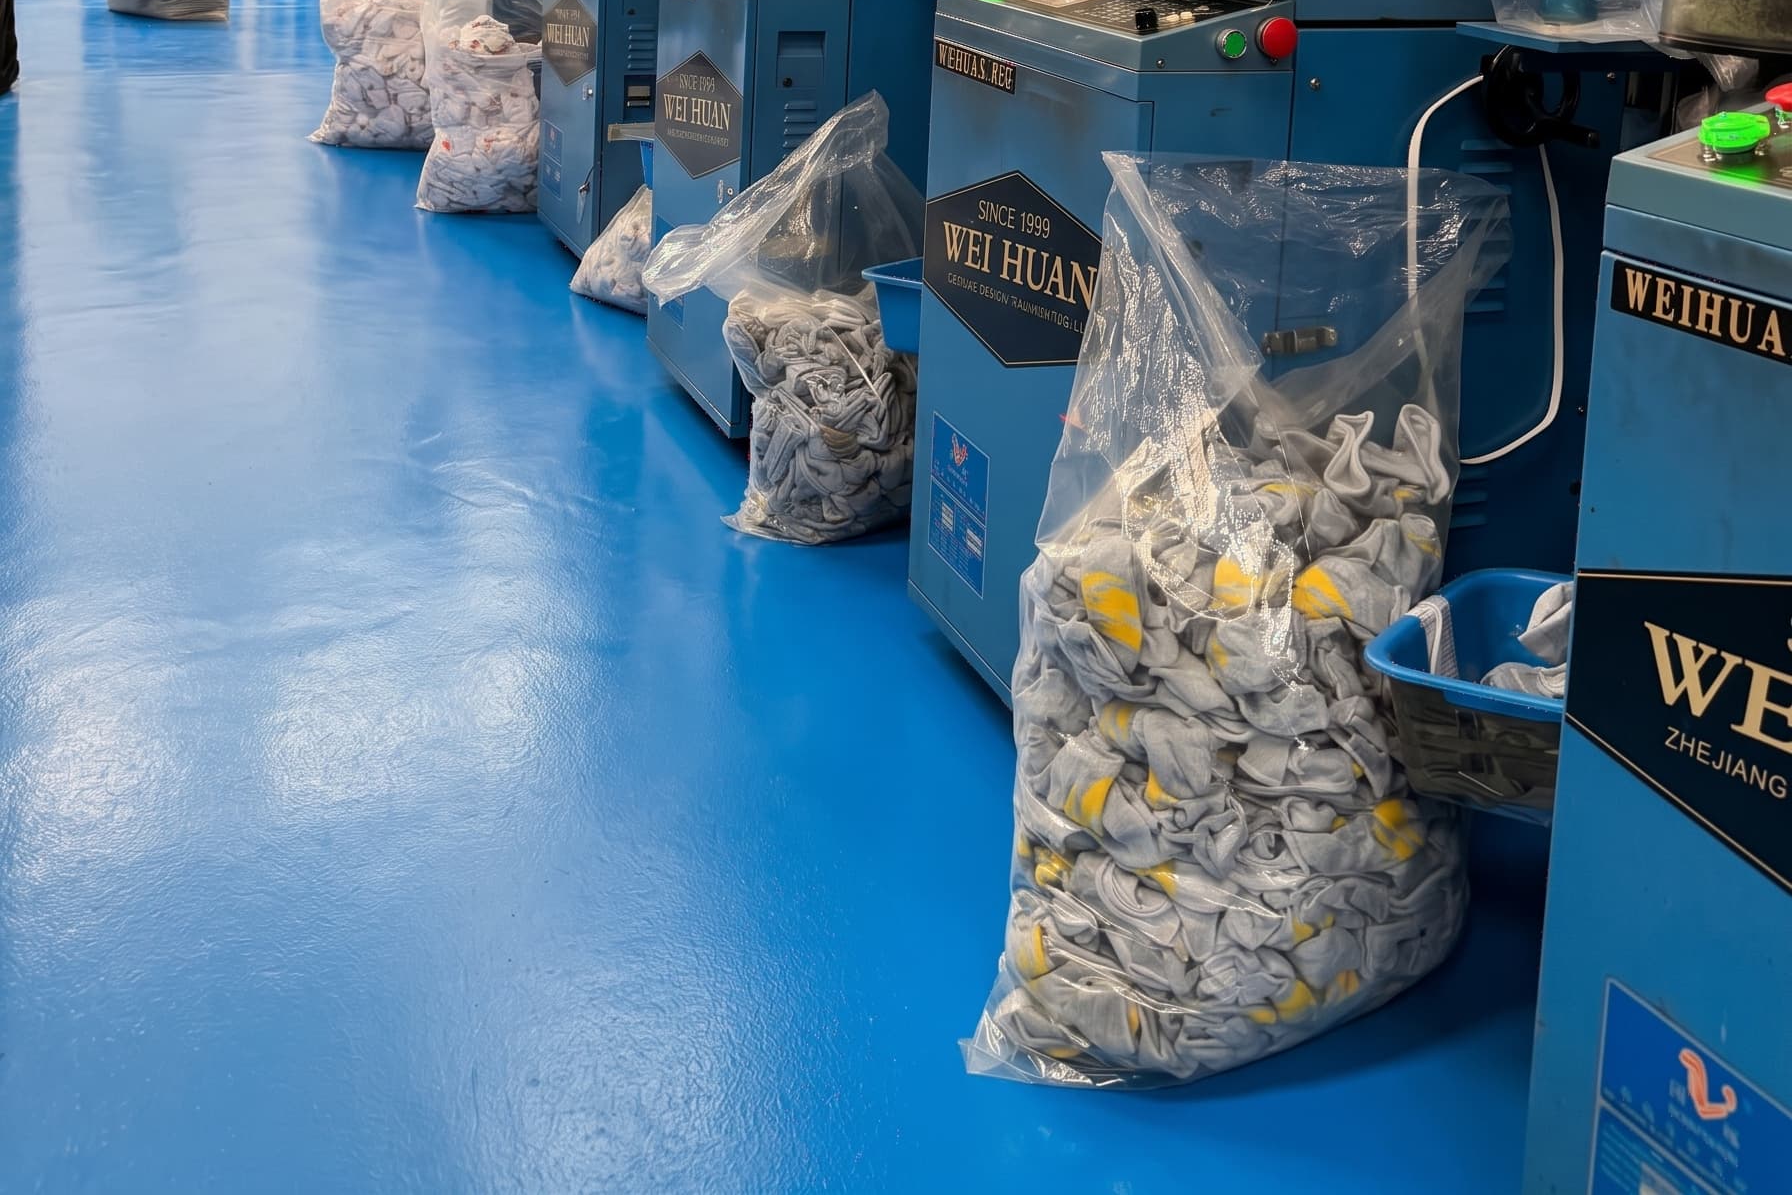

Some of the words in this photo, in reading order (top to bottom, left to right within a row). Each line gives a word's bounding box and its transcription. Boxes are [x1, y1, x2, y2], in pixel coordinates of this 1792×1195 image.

[663, 93, 688, 123] WEI
[691, 97, 731, 131] HUAN
[978, 199, 1016, 229] SINCE
[1020, 211, 1050, 239] 1999
[943, 221, 993, 273] WEI
[1000, 239, 1098, 311] HUAN
[1664, 725, 1787, 799] ZHEJIANG
